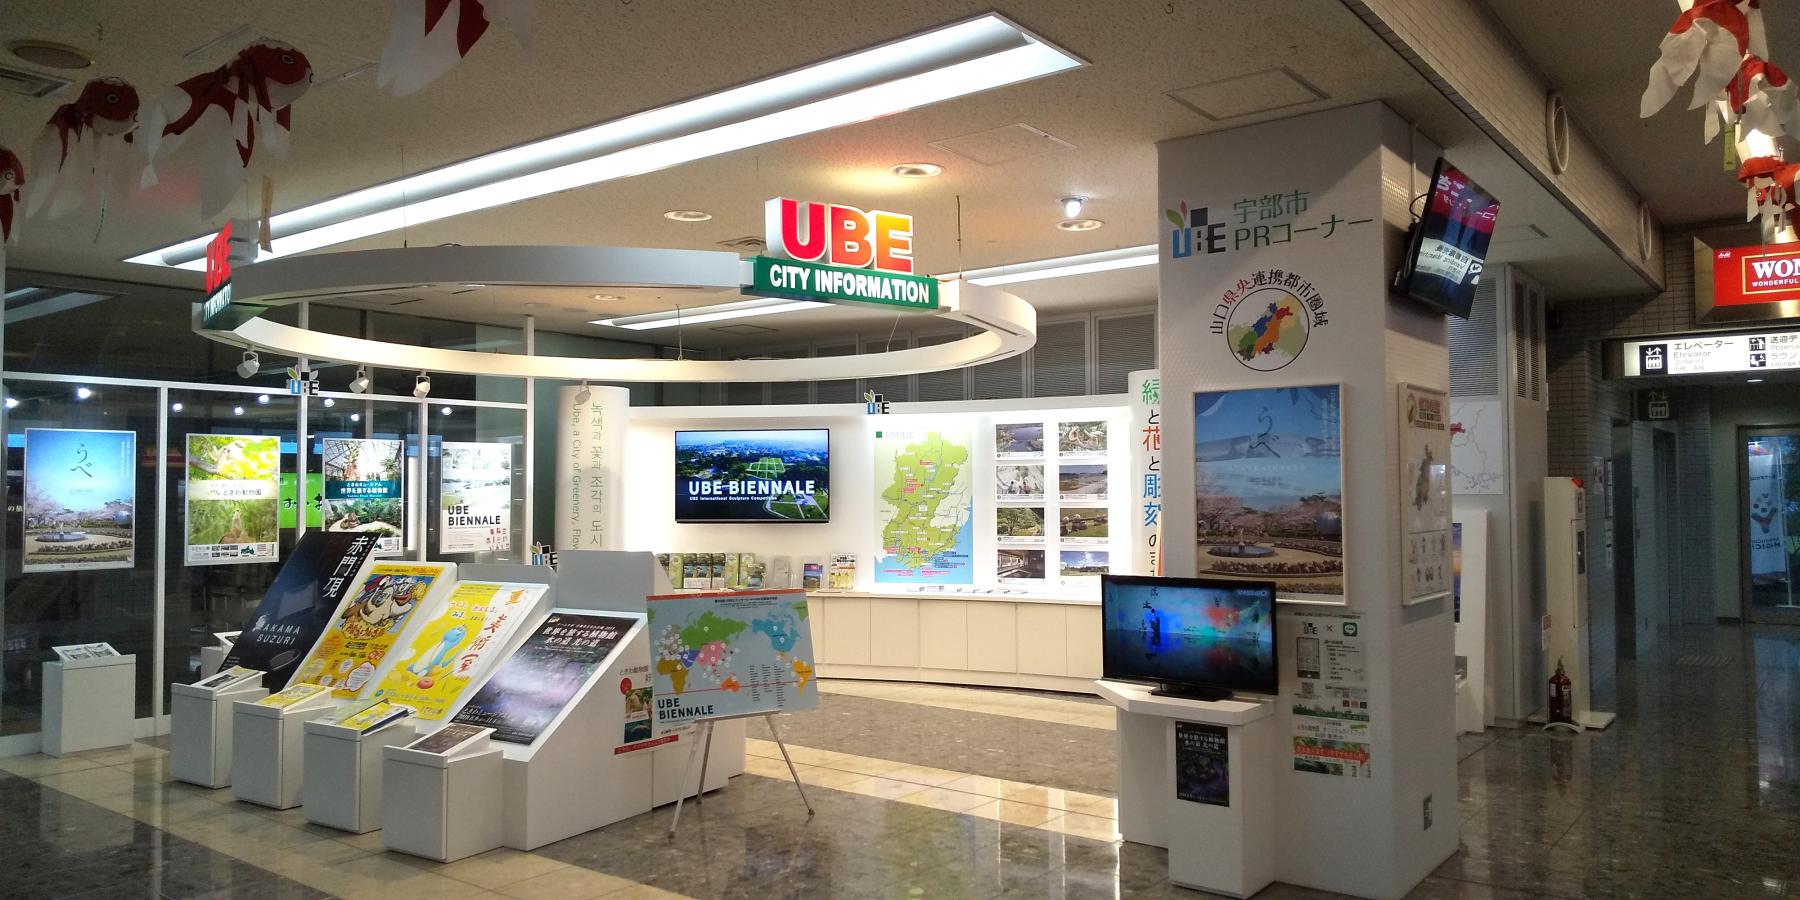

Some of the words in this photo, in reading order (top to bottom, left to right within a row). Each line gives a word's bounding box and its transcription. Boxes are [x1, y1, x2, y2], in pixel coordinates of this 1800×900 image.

[1233, 190, 1309, 225] 宇部市
[764, 196, 914, 274] UBE
[1234, 213, 1374, 250] PRコーナー
[769, 264, 811, 291] CITY
[815, 269, 930, 304] INFORMATION
[1752, 278, 1799, 288] WONDERFUL
[1210, 269, 1329, 335] 山口県央連携都市圏域
[1673, 340, 1735, 350] エレベーター
[590, 402, 603, 440] 녹색과
[1249, 406, 1281, 459] うべ
[70, 443, 93, 477] うべ
[571, 440, 582, 459] City
[590, 446, 603, 470] 꽃과
[571, 476, 582, 525] Greenery,
[590, 476, 603, 513] 조각의
[688, 480, 722, 496] UBE
[729, 480, 815, 495] BIENNALE
[447, 505, 469, 515] UBE
[448, 515, 501, 526] BIENNALE
[590, 520, 603, 547] 도시
[256, 634, 295, 645] SUZURI
[263, 623, 300, 635] AKAMA
[657, 698, 680, 709] UBE
[659, 705, 714, 719] BIENNALE
